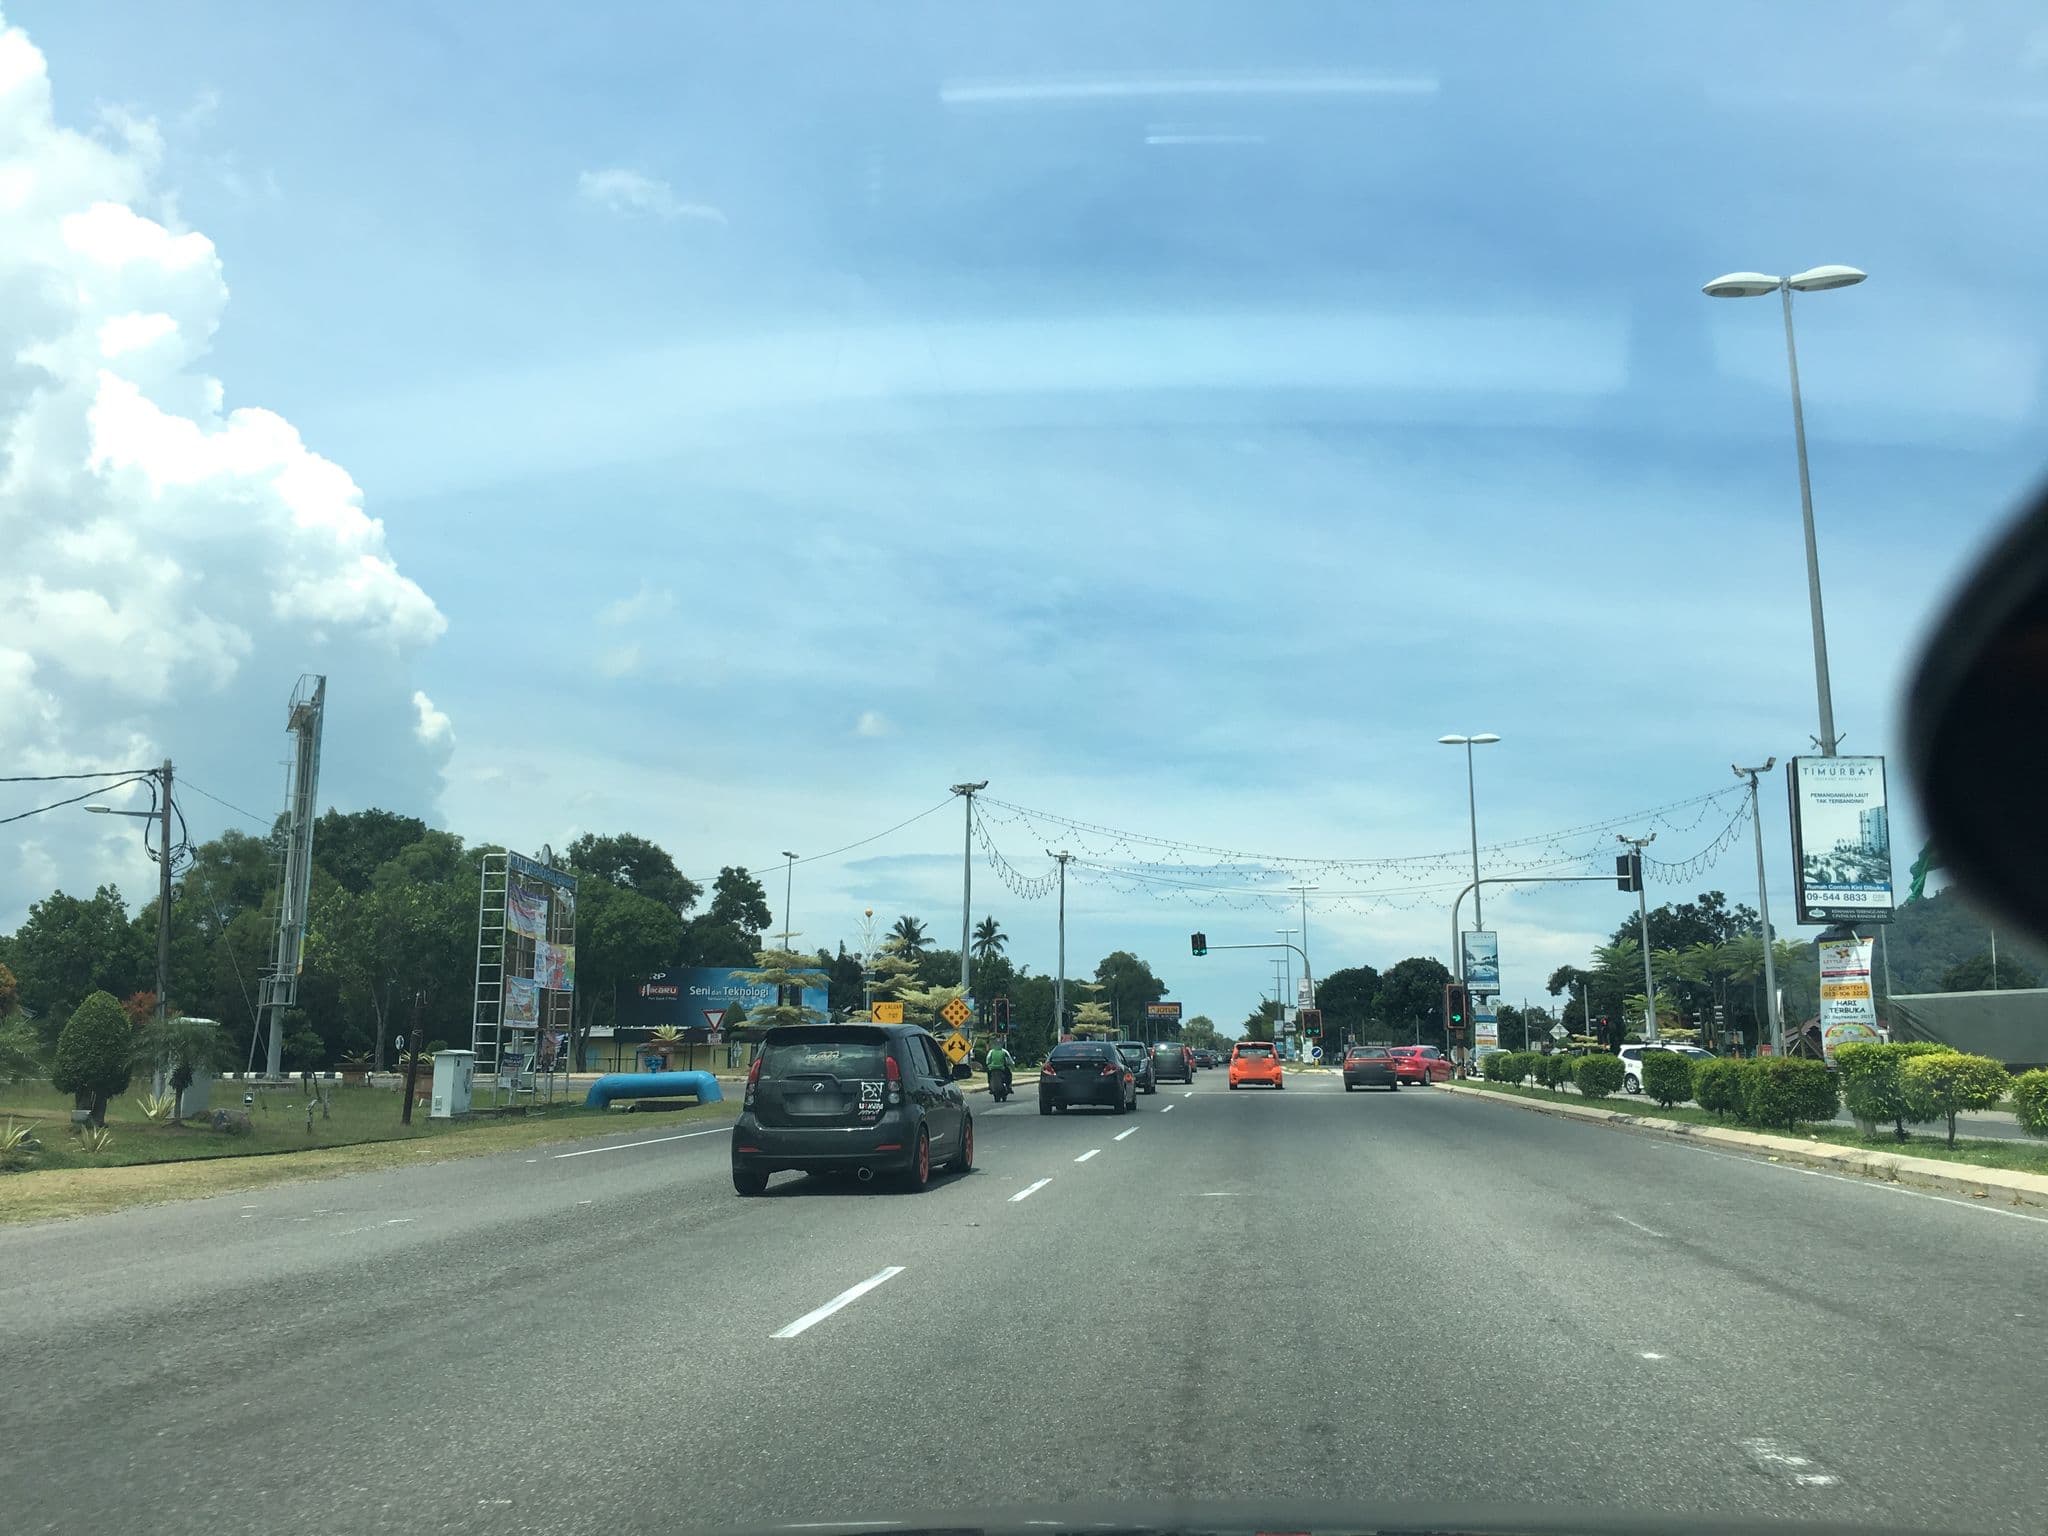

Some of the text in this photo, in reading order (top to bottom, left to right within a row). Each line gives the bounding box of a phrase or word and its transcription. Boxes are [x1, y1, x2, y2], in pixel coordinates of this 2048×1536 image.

[1803, 767, 1874, 776] TIMURBAY
[1806, 893, 1840, 901] 09-544
[1843, 893, 1867, 901] 8833
[689, 986, 711, 995] Seni
[723, 986, 769, 998] Teknologi
